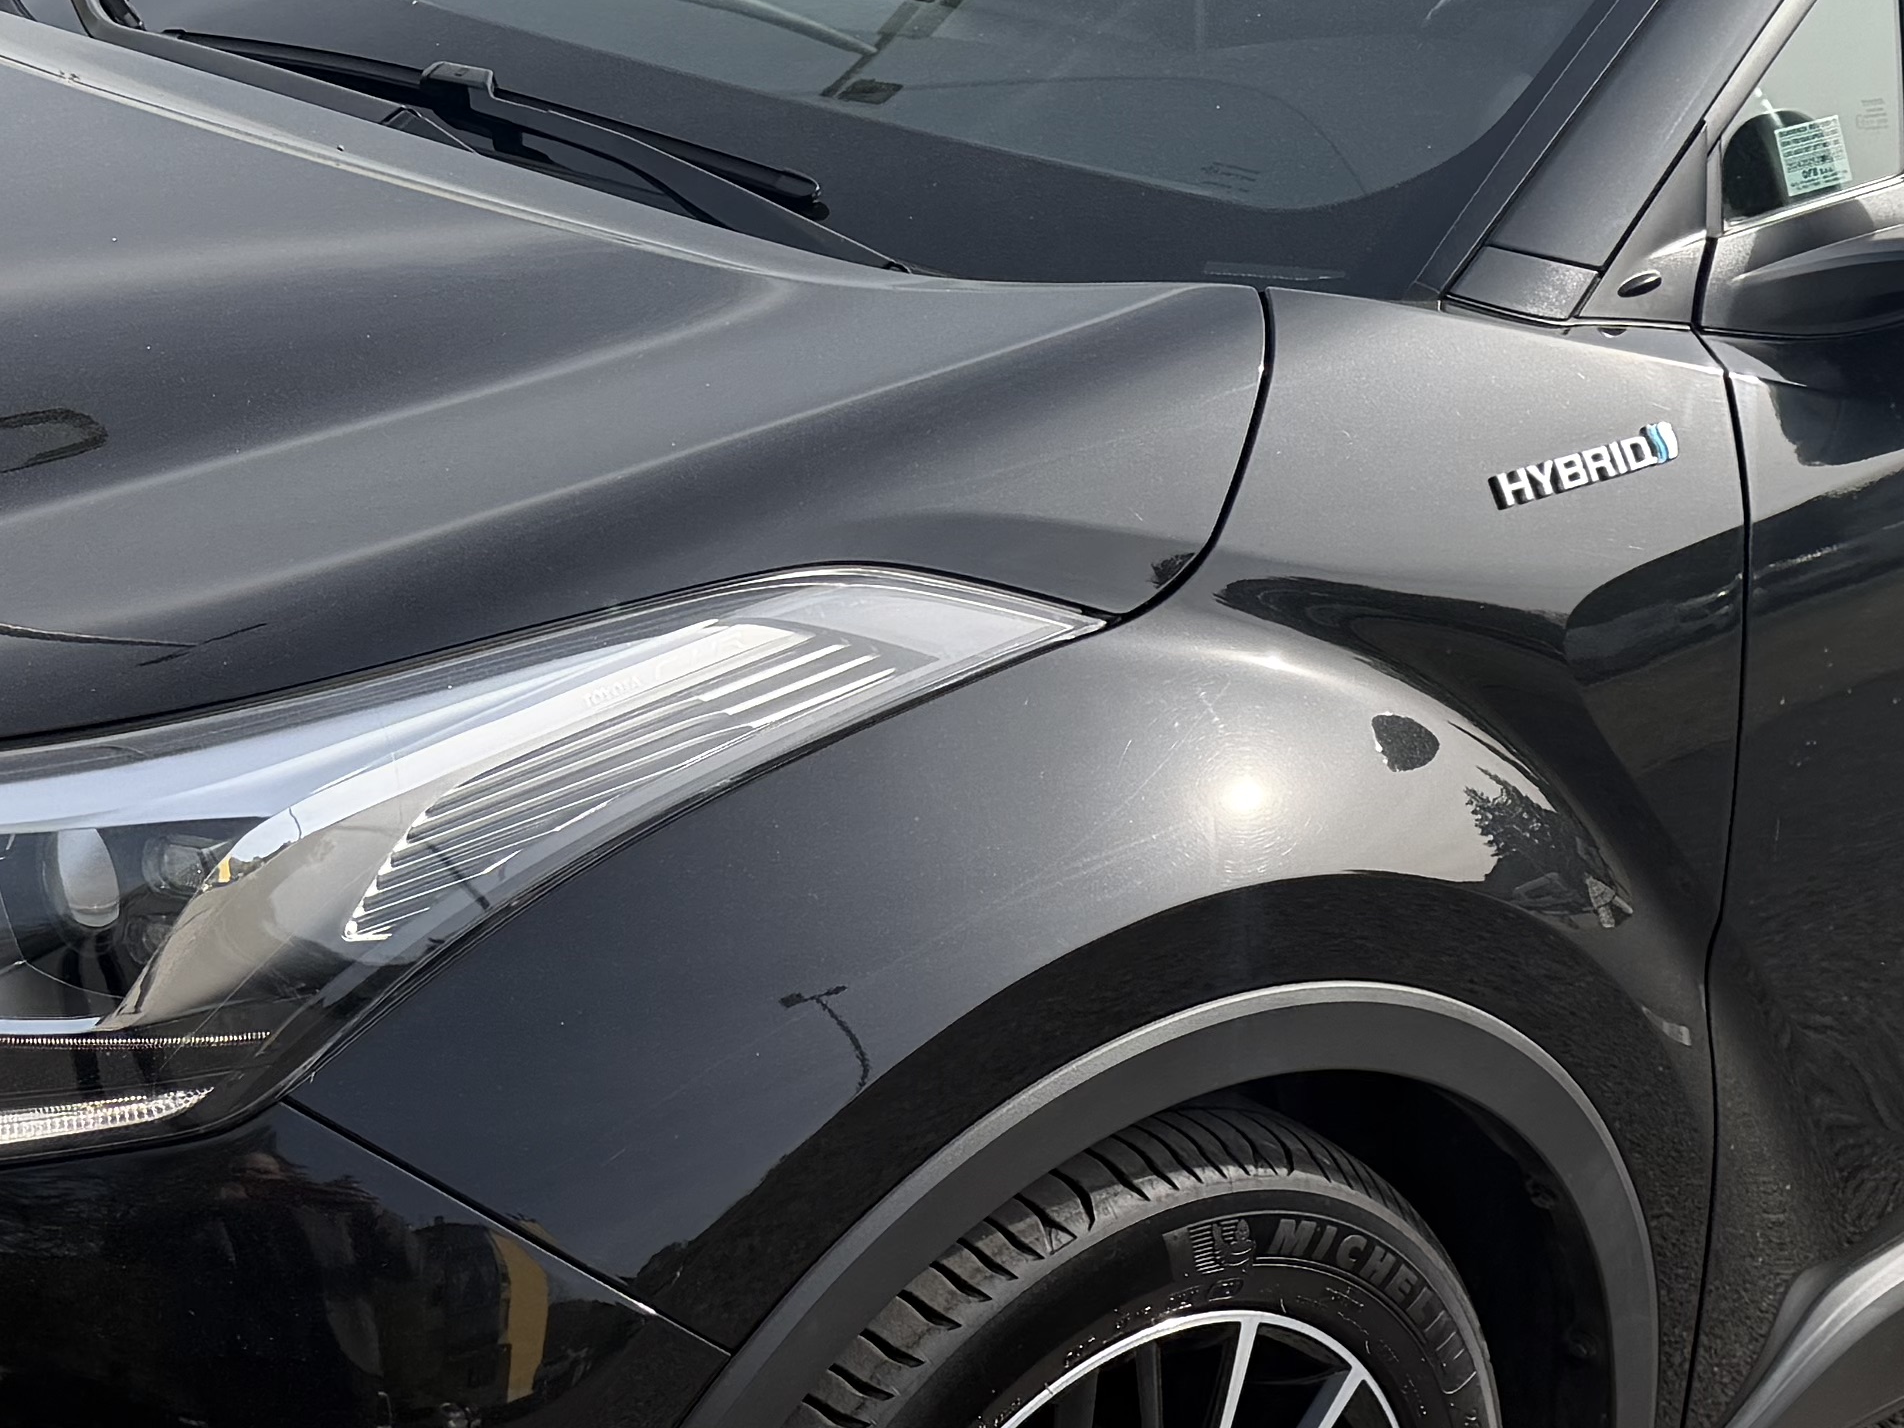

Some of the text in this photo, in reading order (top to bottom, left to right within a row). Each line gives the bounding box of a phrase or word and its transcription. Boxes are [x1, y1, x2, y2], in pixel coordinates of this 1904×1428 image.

[1492, 435, 1660, 509] HYBRID
[585, 674, 643, 707] TOYOTA
[1266, 1216, 1467, 1370] MICHELIN
